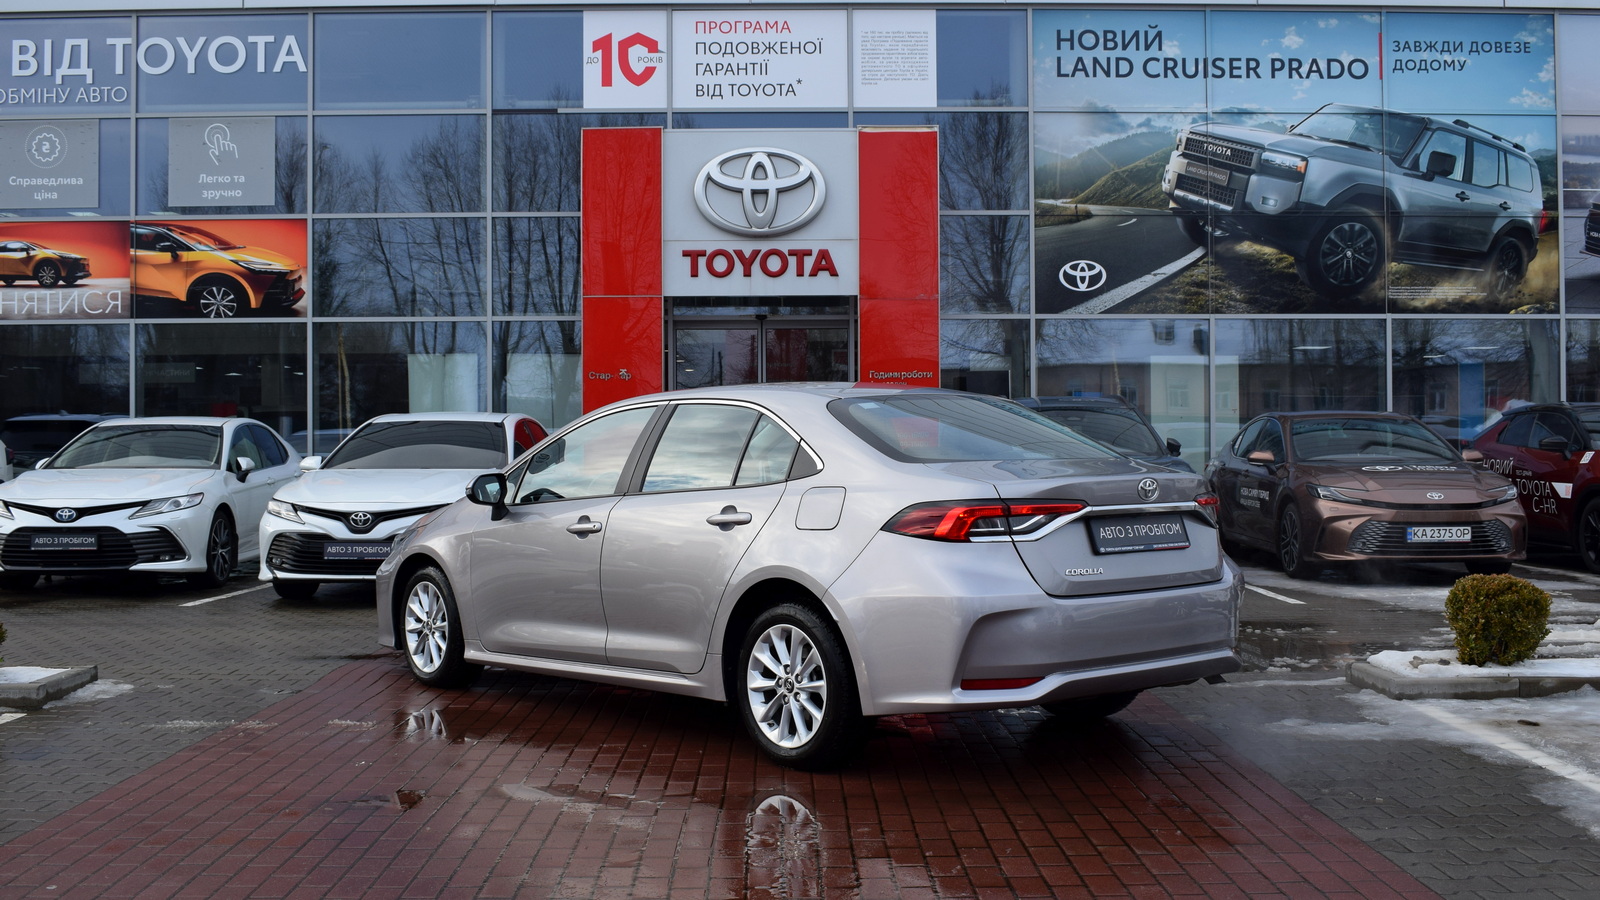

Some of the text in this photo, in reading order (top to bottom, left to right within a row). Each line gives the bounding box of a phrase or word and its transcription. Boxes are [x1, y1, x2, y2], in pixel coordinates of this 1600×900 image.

[695, 20, 791, 34] ПРОГРАМА
[1056, 24, 1163, 51] НОВИЙ
[695, 38, 823, 58] ПОДОВЖЕНОЇ
[1392, 40, 1531, 56] ЗАВЖДИ ДОВЕЗЕ
[12, 35, 307, 84] ВІД TOYOTA
[586, 56, 599, 65] ДО
[637, 56, 663, 64] РОКІВ
[695, 59, 770, 76] ГАРАНТІЇ
[1392, 59, 1467, 74] ДОДОМУ
[1056, 56, 1369, 80] LAND CRUISER PRADO
[76, 86, 128, 103] АВТО
[695, 84, 723, 100] ВІД
[1204, 143, 1231, 156] TOYOTA
[9, 176, 83, 187] Справедлива
[198, 174, 245, 185] Легко та
[34, 190, 58, 200] ціна
[201, 189, 242, 199] зручно
[682, 249, 839, 278] TOYOTA
[0, 290, 122, 314] НЯТИСЯ
[901, 370, 932, 380] роботи
[1516, 478, 1552, 497] TOYOTA
[1532, 497, 1558, 514] C-HR
[1100, 526, 1124, 539] АВТО
[1134, 523, 1181, 537] ПРОБІГОМ
[1413, 528, 1470, 538] KA 2375 OP
[1065, 567, 1104, 576] COROLLA
